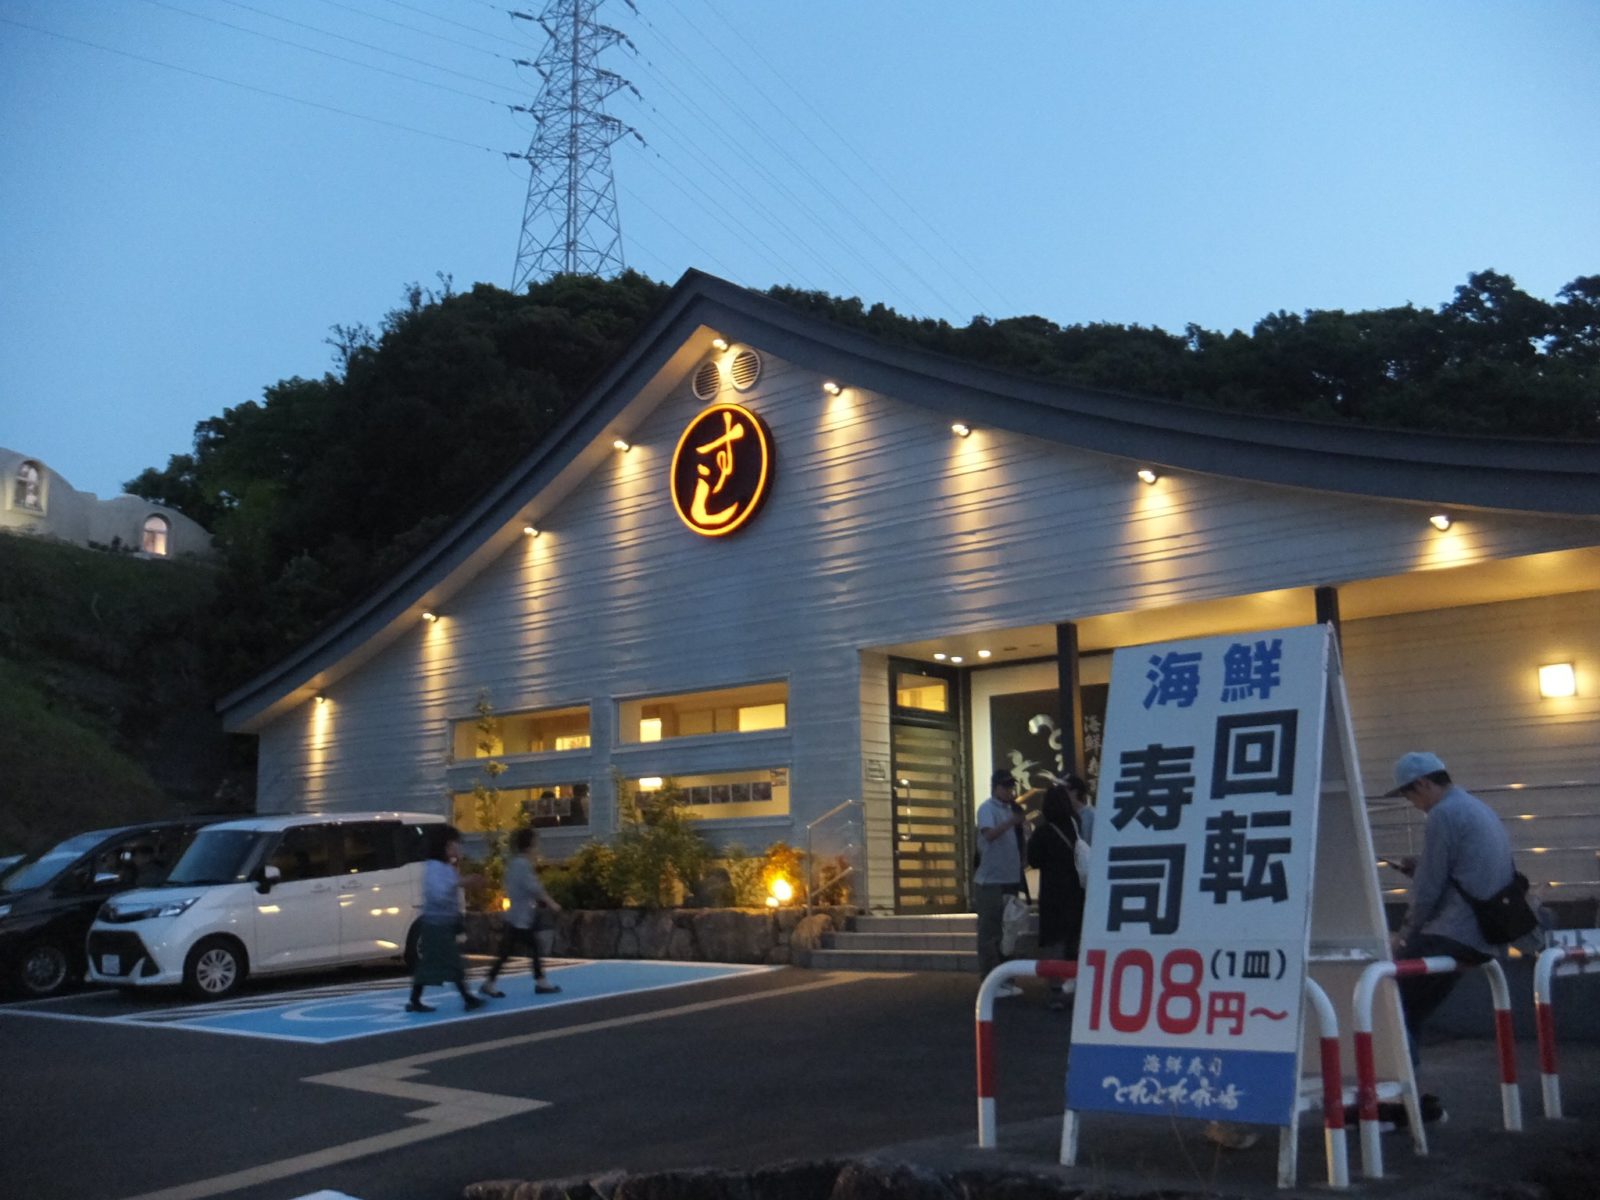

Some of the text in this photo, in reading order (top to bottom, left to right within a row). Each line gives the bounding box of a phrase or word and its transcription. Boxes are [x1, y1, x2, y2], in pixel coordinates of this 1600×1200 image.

[690, 411, 745, 525] すし
[1143, 638, 1282, 709] 海鮮
[1109, 743, 1195, 935] 寿司
[1199, 709, 1298, 904] 回転
[1211, 949, 1287, 980] (1皿)
